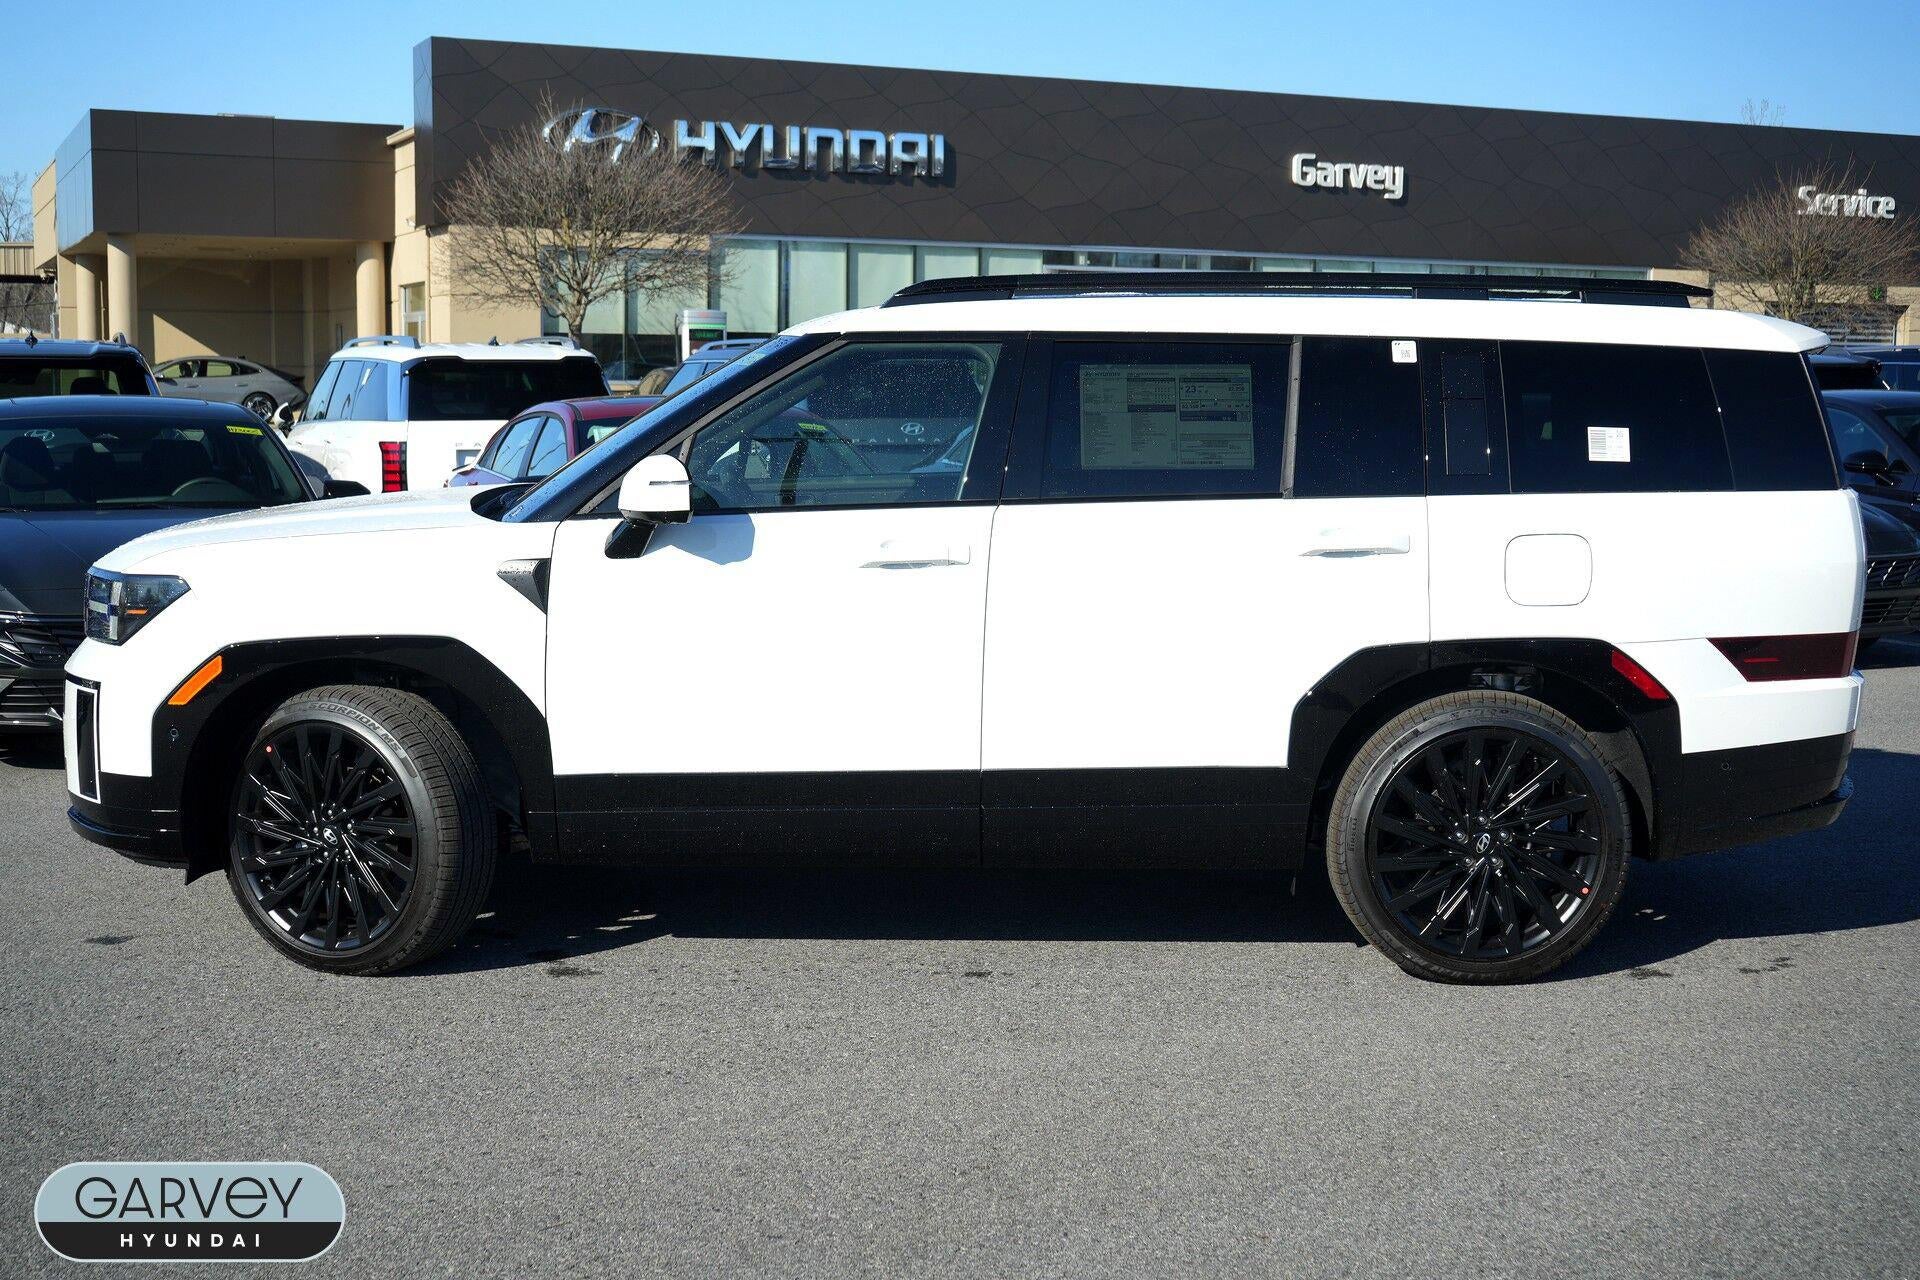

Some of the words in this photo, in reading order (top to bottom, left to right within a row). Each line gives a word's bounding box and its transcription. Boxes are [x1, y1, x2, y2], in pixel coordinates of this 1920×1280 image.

[673, 119, 945, 177] HYUNDAI
[1291, 152, 1404, 199] Garvey
[1797, 185, 1896, 219] Service
[308, 701, 381, 731] SCORPION
